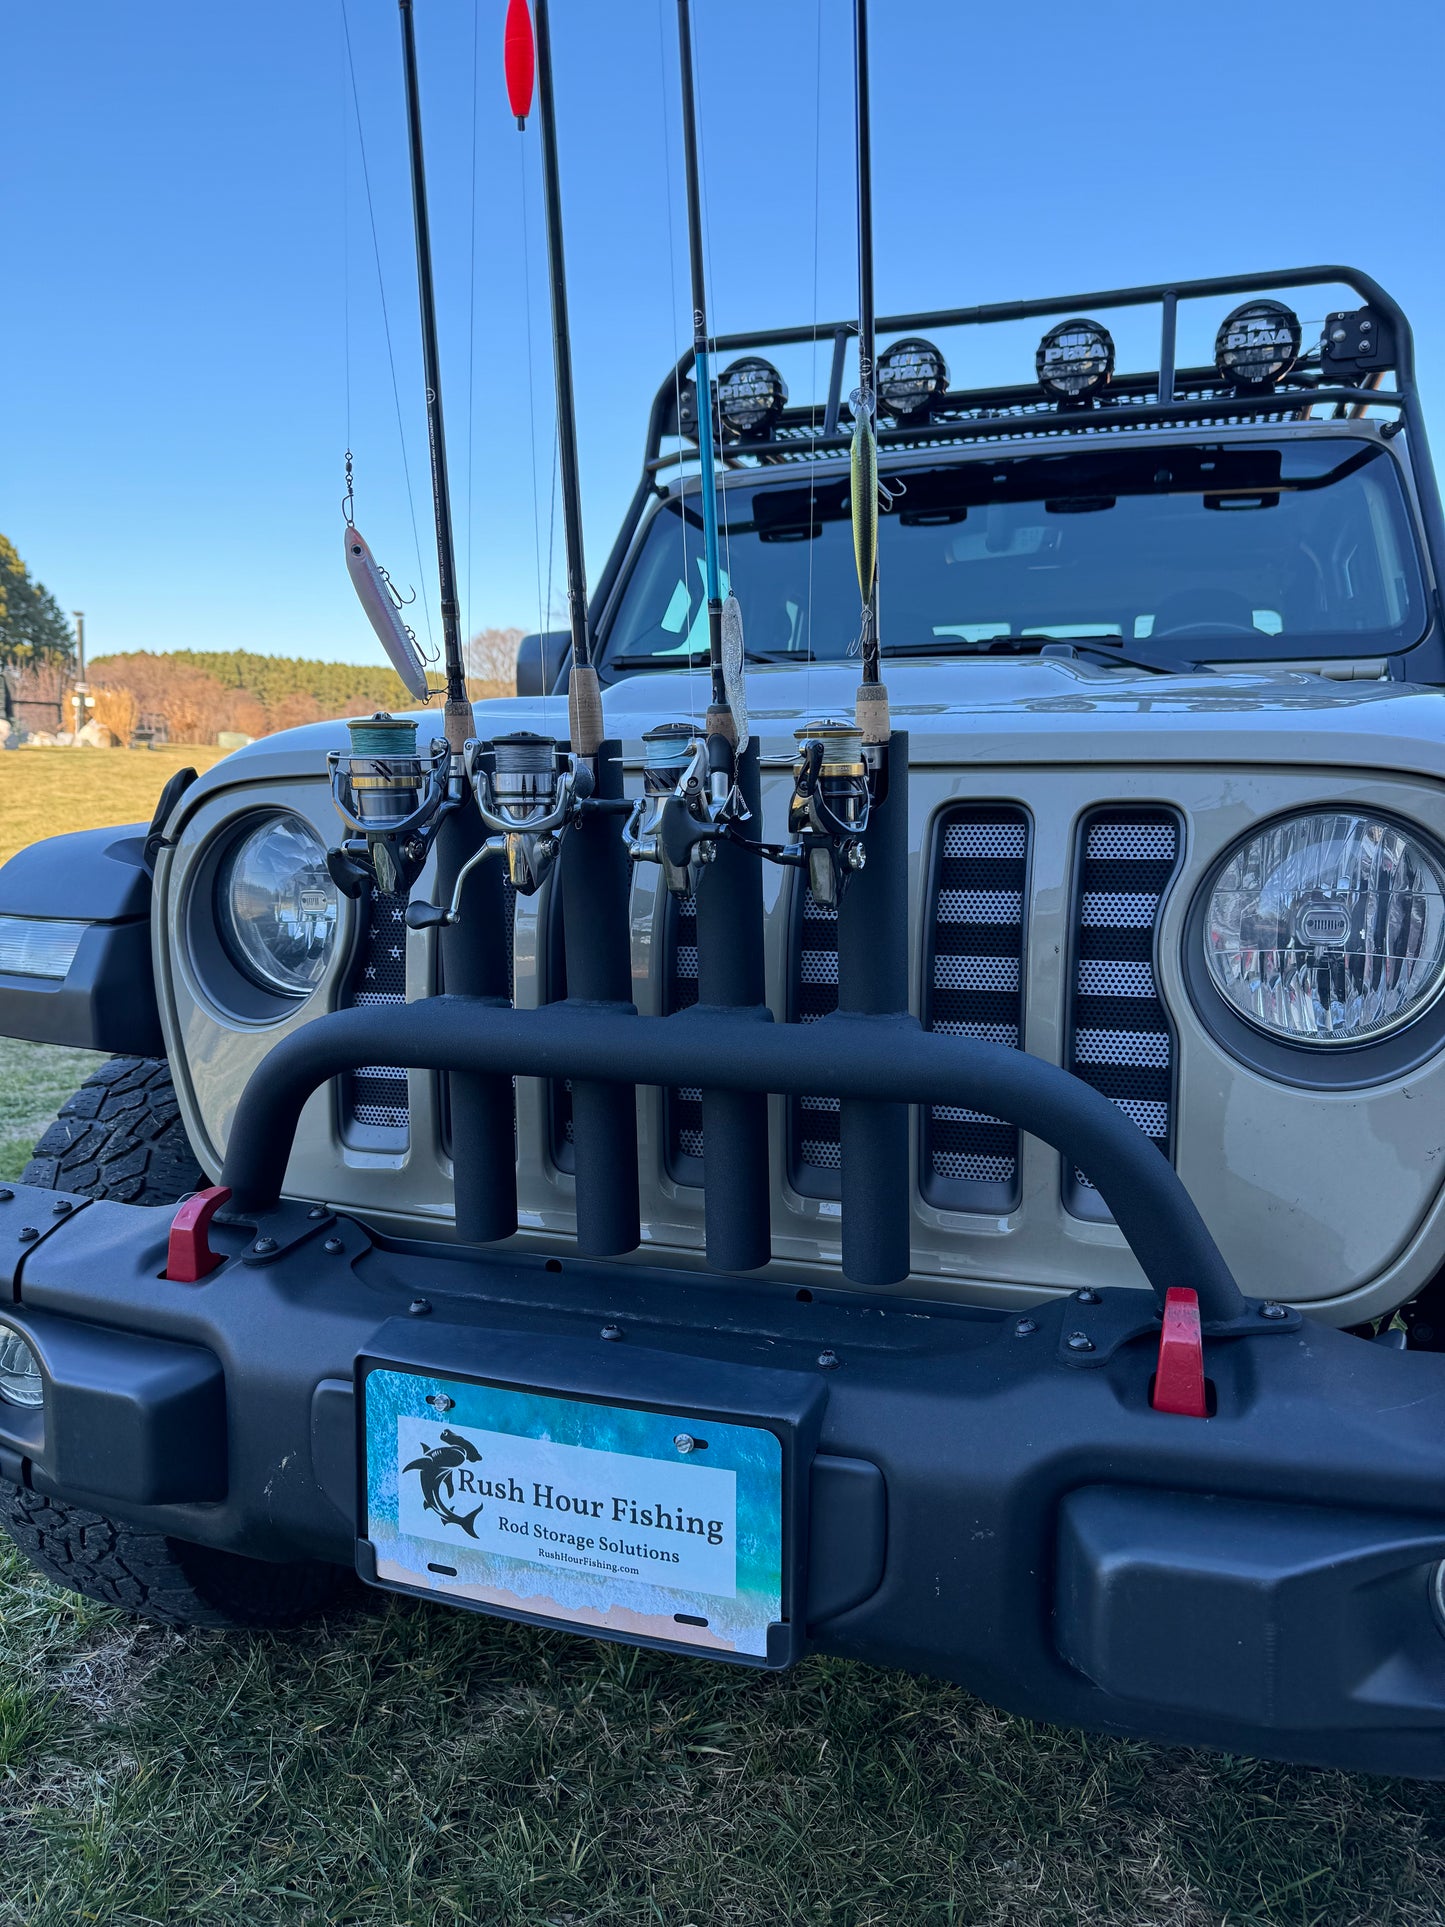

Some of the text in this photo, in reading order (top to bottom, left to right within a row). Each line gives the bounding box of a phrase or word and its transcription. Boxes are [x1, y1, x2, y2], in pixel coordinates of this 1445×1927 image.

[1228, 329, 1293, 350] PIAA
[1045, 344, 1105, 363] PIAA
[879, 364, 934, 382] PIAA
[720, 382, 769, 400] PIAA
[458, 1468, 724, 1546] Rush Hour Fishing
[498, 1516, 680, 1563] Rod Storage Solutions
[538, 1548, 640, 1575] RushHourFishing.com
